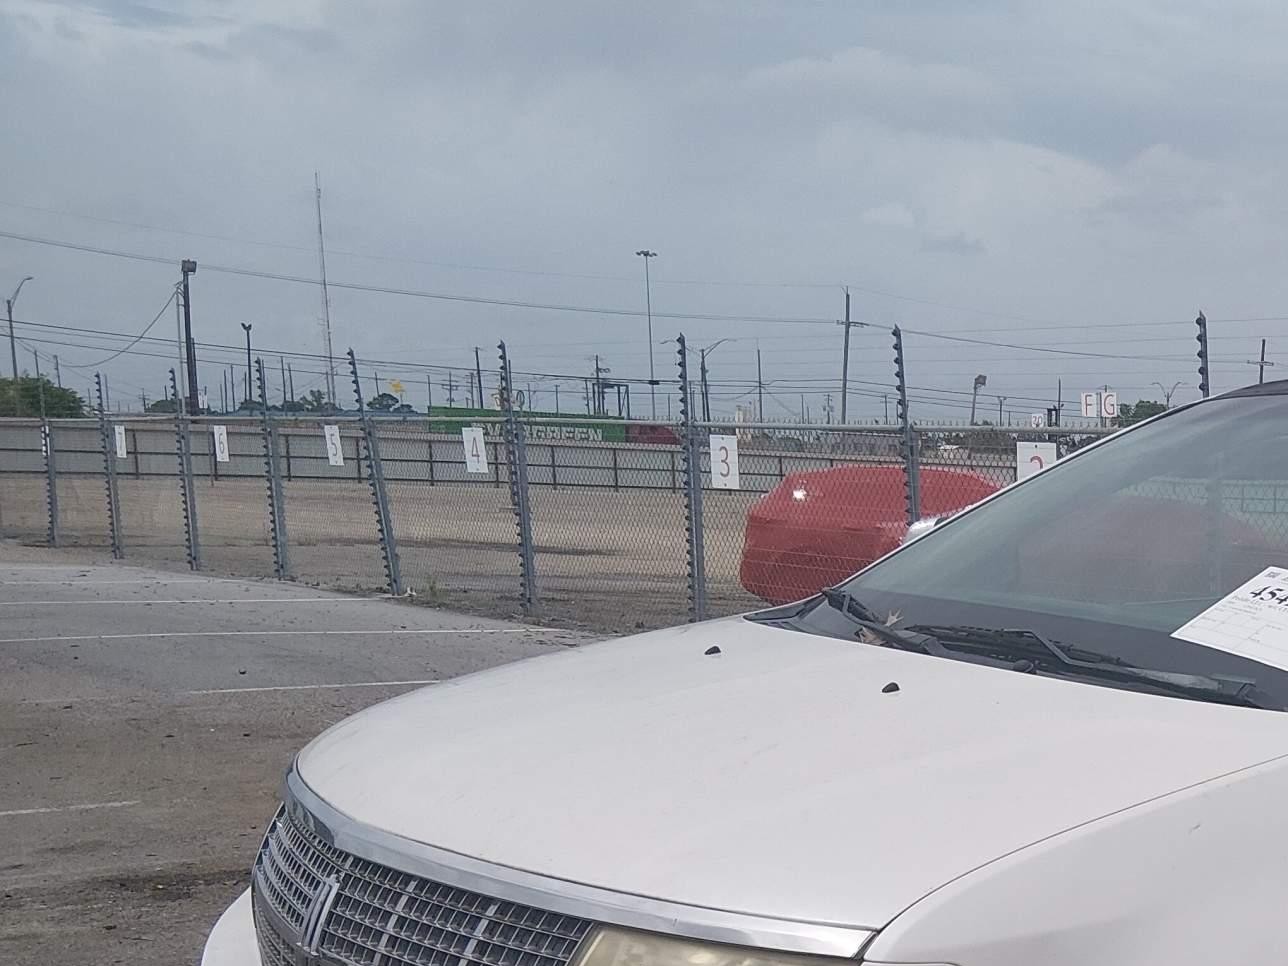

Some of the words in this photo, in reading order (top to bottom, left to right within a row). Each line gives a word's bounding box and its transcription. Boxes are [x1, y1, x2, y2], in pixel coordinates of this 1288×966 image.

[1085, 394, 1093, 416] F
[1103, 394, 1115, 416] G
[218, 432, 225, 454] 6
[330, 433, 338, 456] 5
[471, 436, 481, 464] 4
[719, 446, 730, 478] 3
